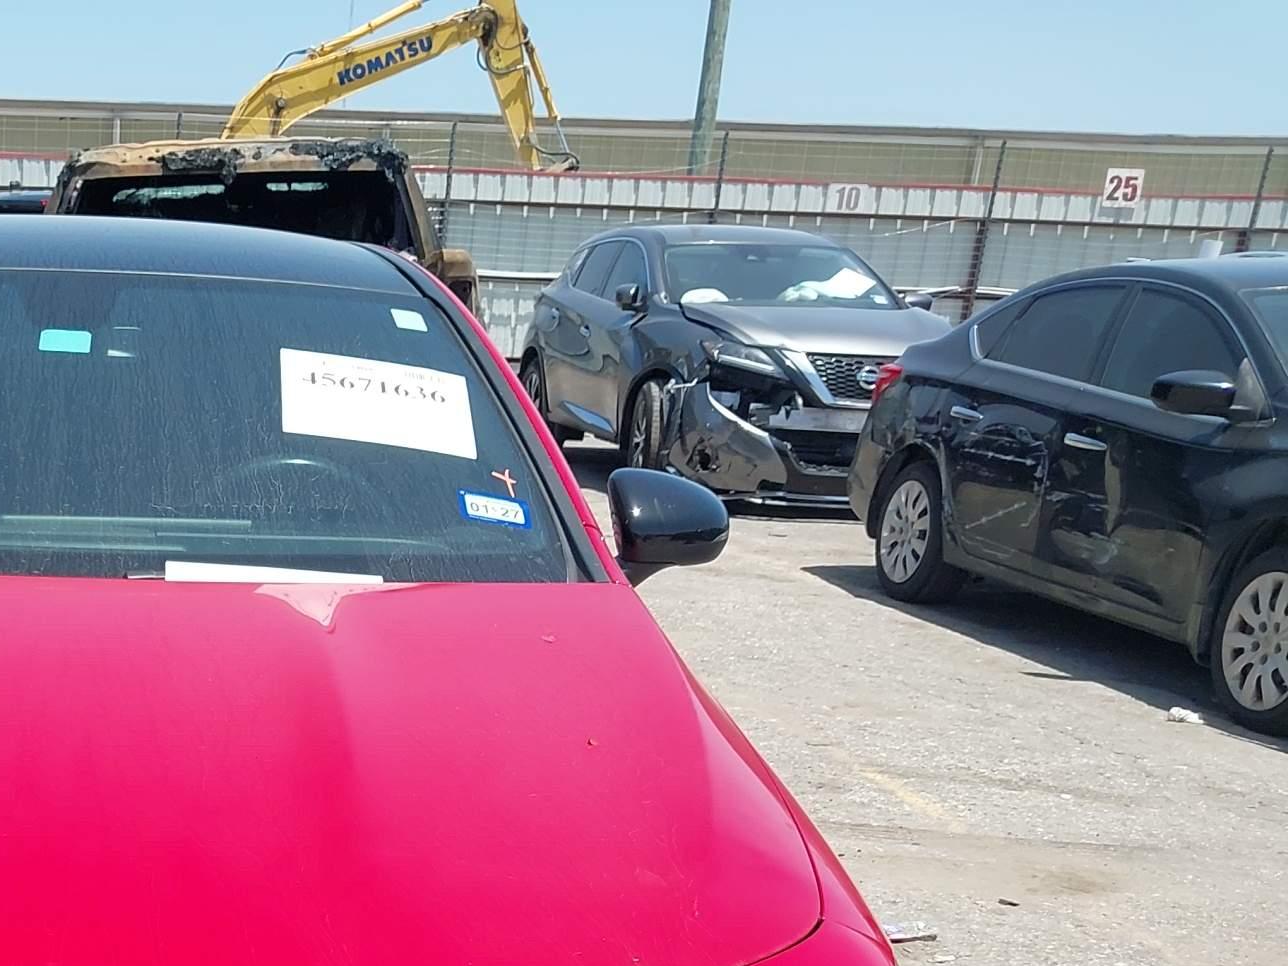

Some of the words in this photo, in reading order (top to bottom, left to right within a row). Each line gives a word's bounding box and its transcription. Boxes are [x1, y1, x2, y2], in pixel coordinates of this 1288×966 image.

[337, 36, 433, 86] KOMATSU
[835, 186, 861, 211] 10
[1106, 174, 1138, 202] 25
[302, 371, 446, 403] 45671636
